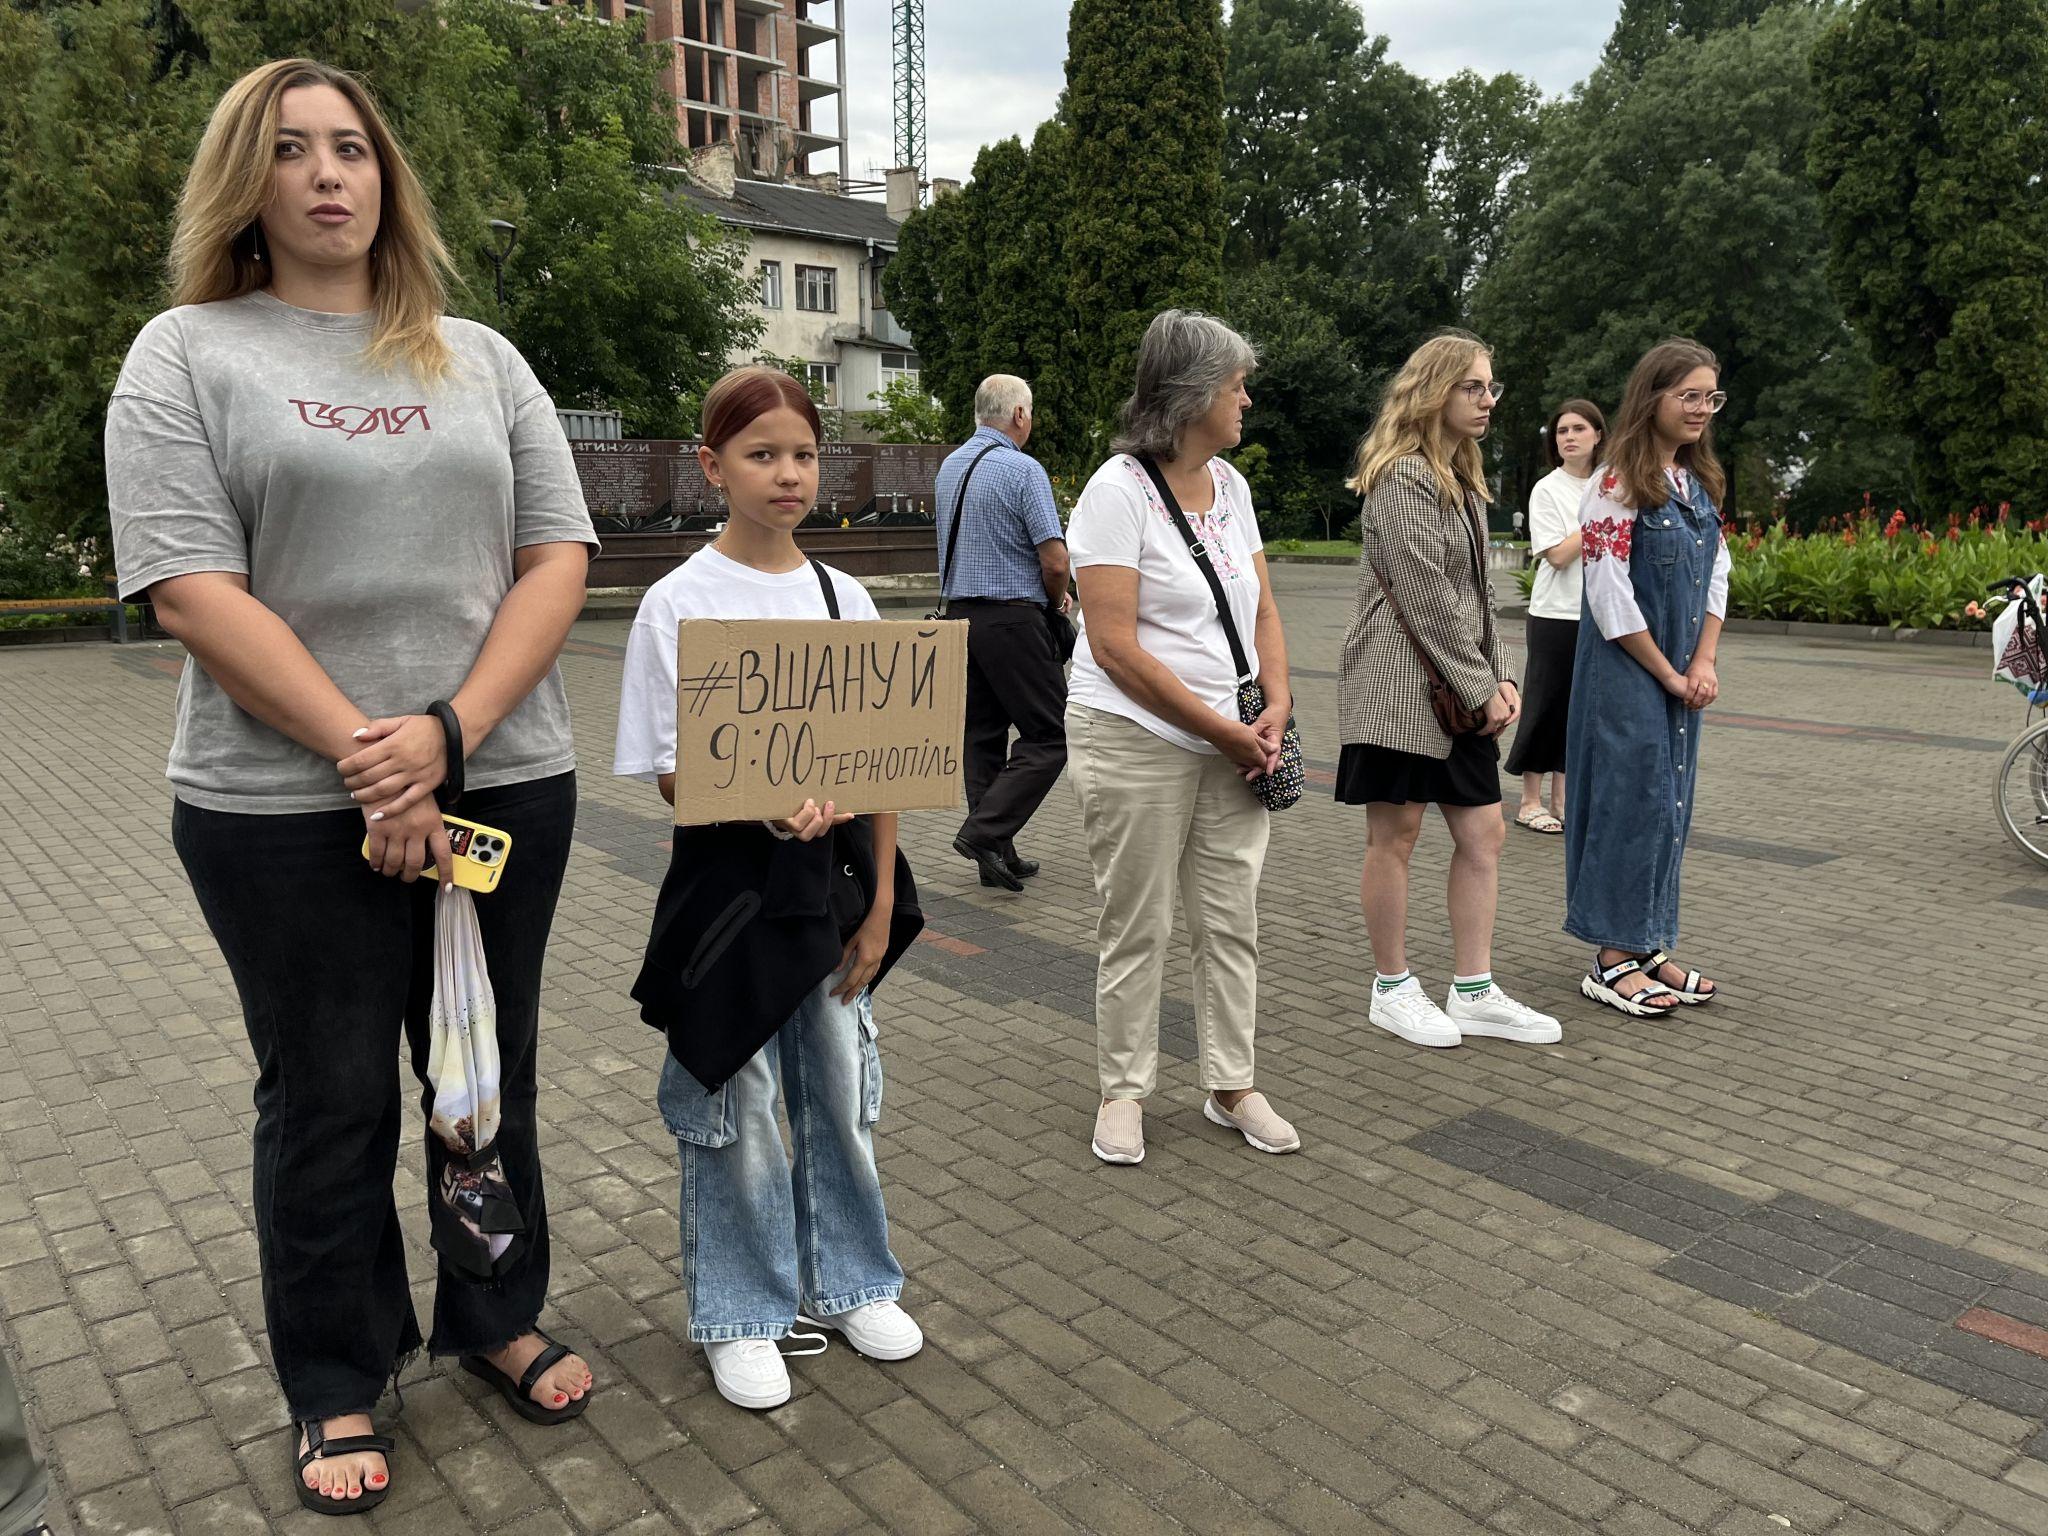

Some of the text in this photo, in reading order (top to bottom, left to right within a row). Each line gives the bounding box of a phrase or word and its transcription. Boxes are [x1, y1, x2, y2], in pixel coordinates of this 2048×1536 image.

[288, 398, 431, 441] ВОЛЯ
[680, 628, 938, 717] #ВШАНУЙ
[709, 721, 957, 789] 9:00 ТЕРНОПІЛЬ
